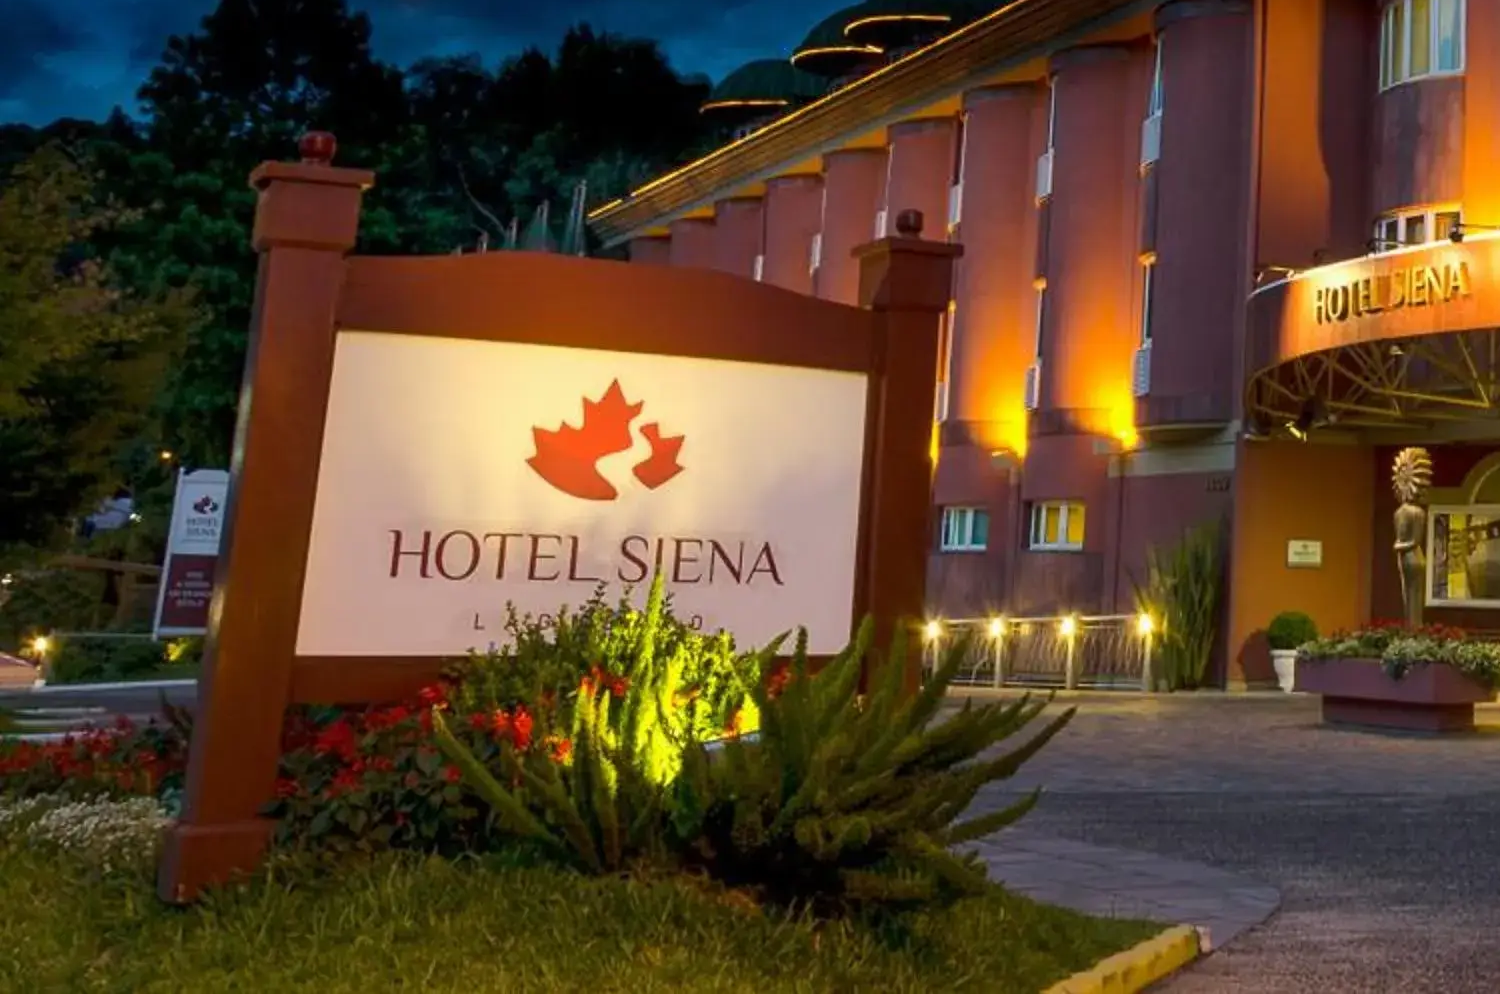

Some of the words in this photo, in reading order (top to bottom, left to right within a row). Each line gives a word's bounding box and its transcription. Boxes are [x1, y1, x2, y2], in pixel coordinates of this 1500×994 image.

[1314, 268, 1385, 325] HOTEL
[1390, 261, 1473, 310] SIENA
[388, 529, 603, 582] HOTEL
[617, 534, 785, 586] SIENA
